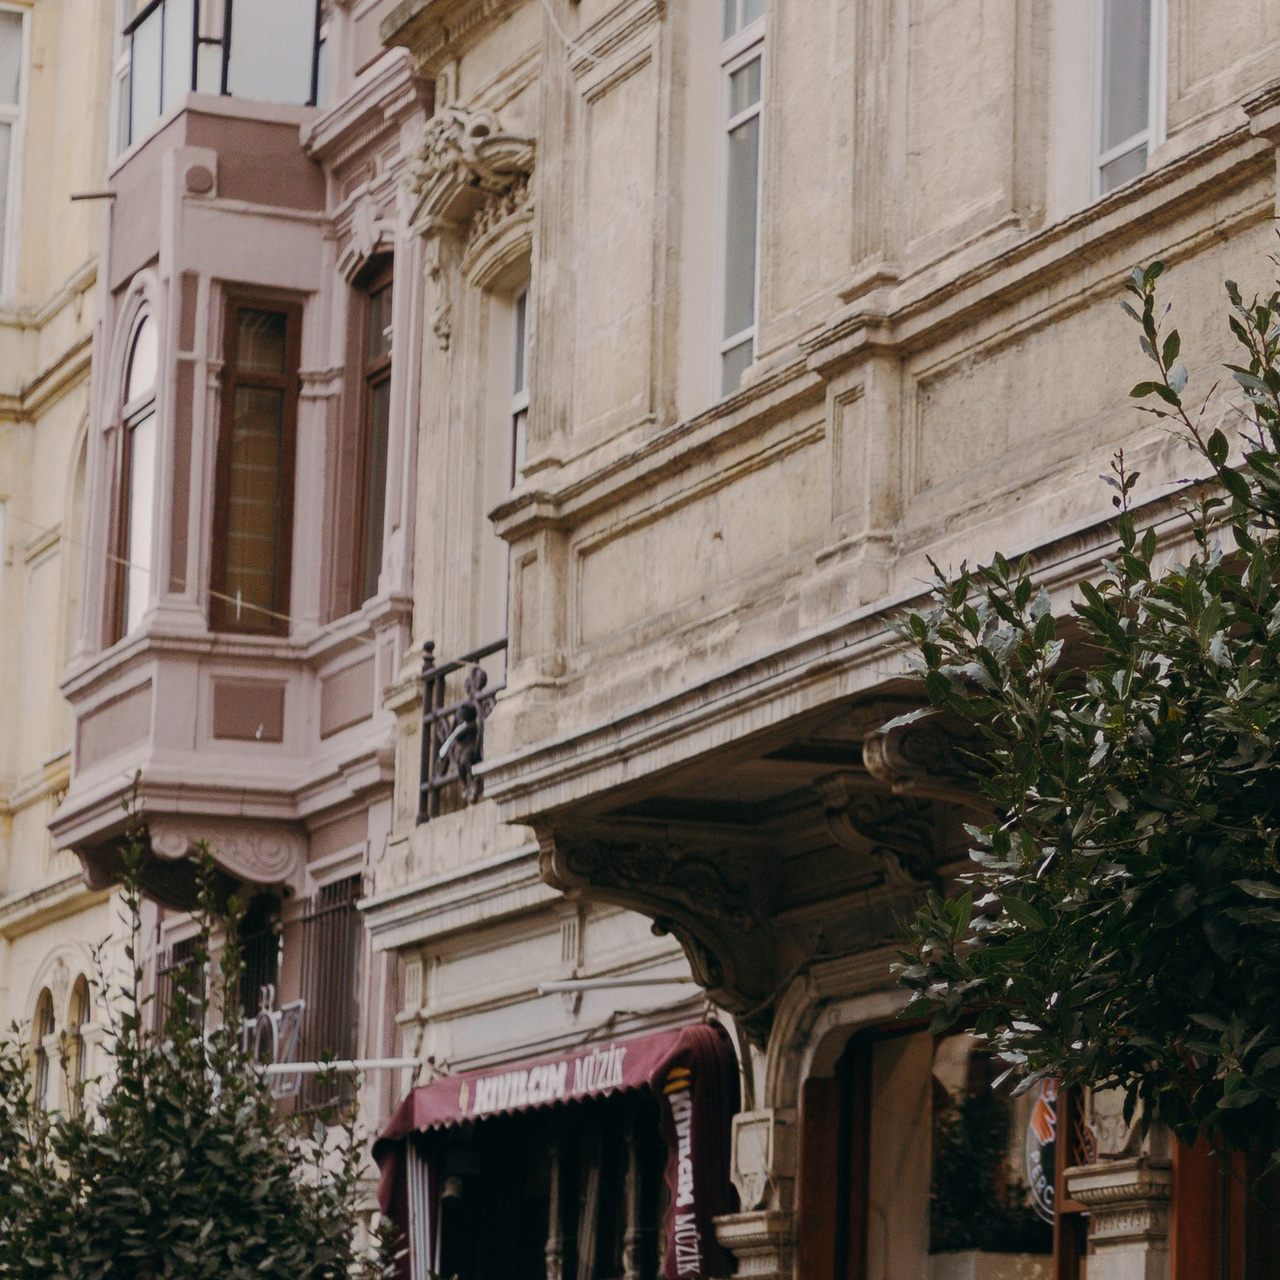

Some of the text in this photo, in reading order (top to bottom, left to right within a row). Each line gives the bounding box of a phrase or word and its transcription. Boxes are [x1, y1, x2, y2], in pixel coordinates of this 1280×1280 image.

[473, 1042, 627, 1116] KIVILCIM MÜZİK
[674, 1213, 702, 1275] MÜZİK
